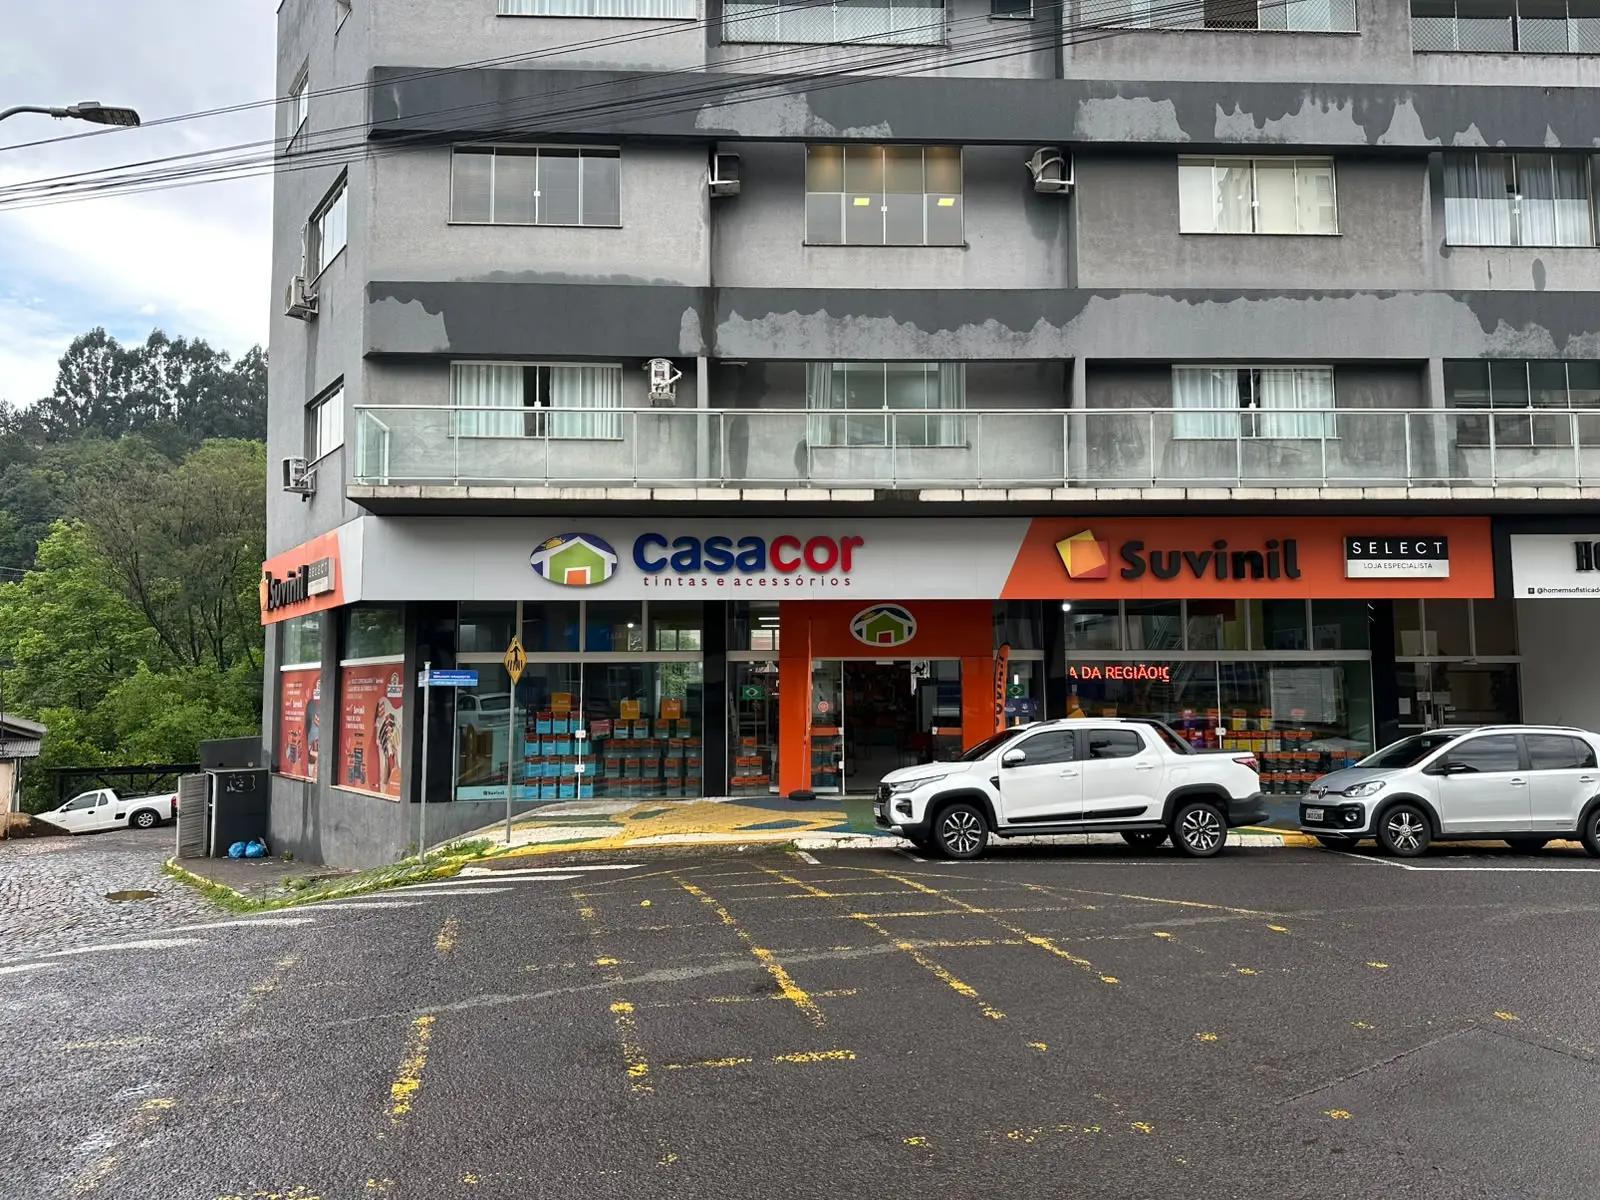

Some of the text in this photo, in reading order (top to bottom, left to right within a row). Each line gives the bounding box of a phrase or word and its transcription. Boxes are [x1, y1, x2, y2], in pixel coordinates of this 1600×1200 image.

[1352, 541, 1442, 554] SELECT
[1121, 539, 1301, 579] Suvinil
[308, 562, 328, 578] SELECT
[643, 574, 851, 586] tintas e acessórios
[268, 565, 309, 611] Suvinil
[1081, 666, 1102, 679] DA
